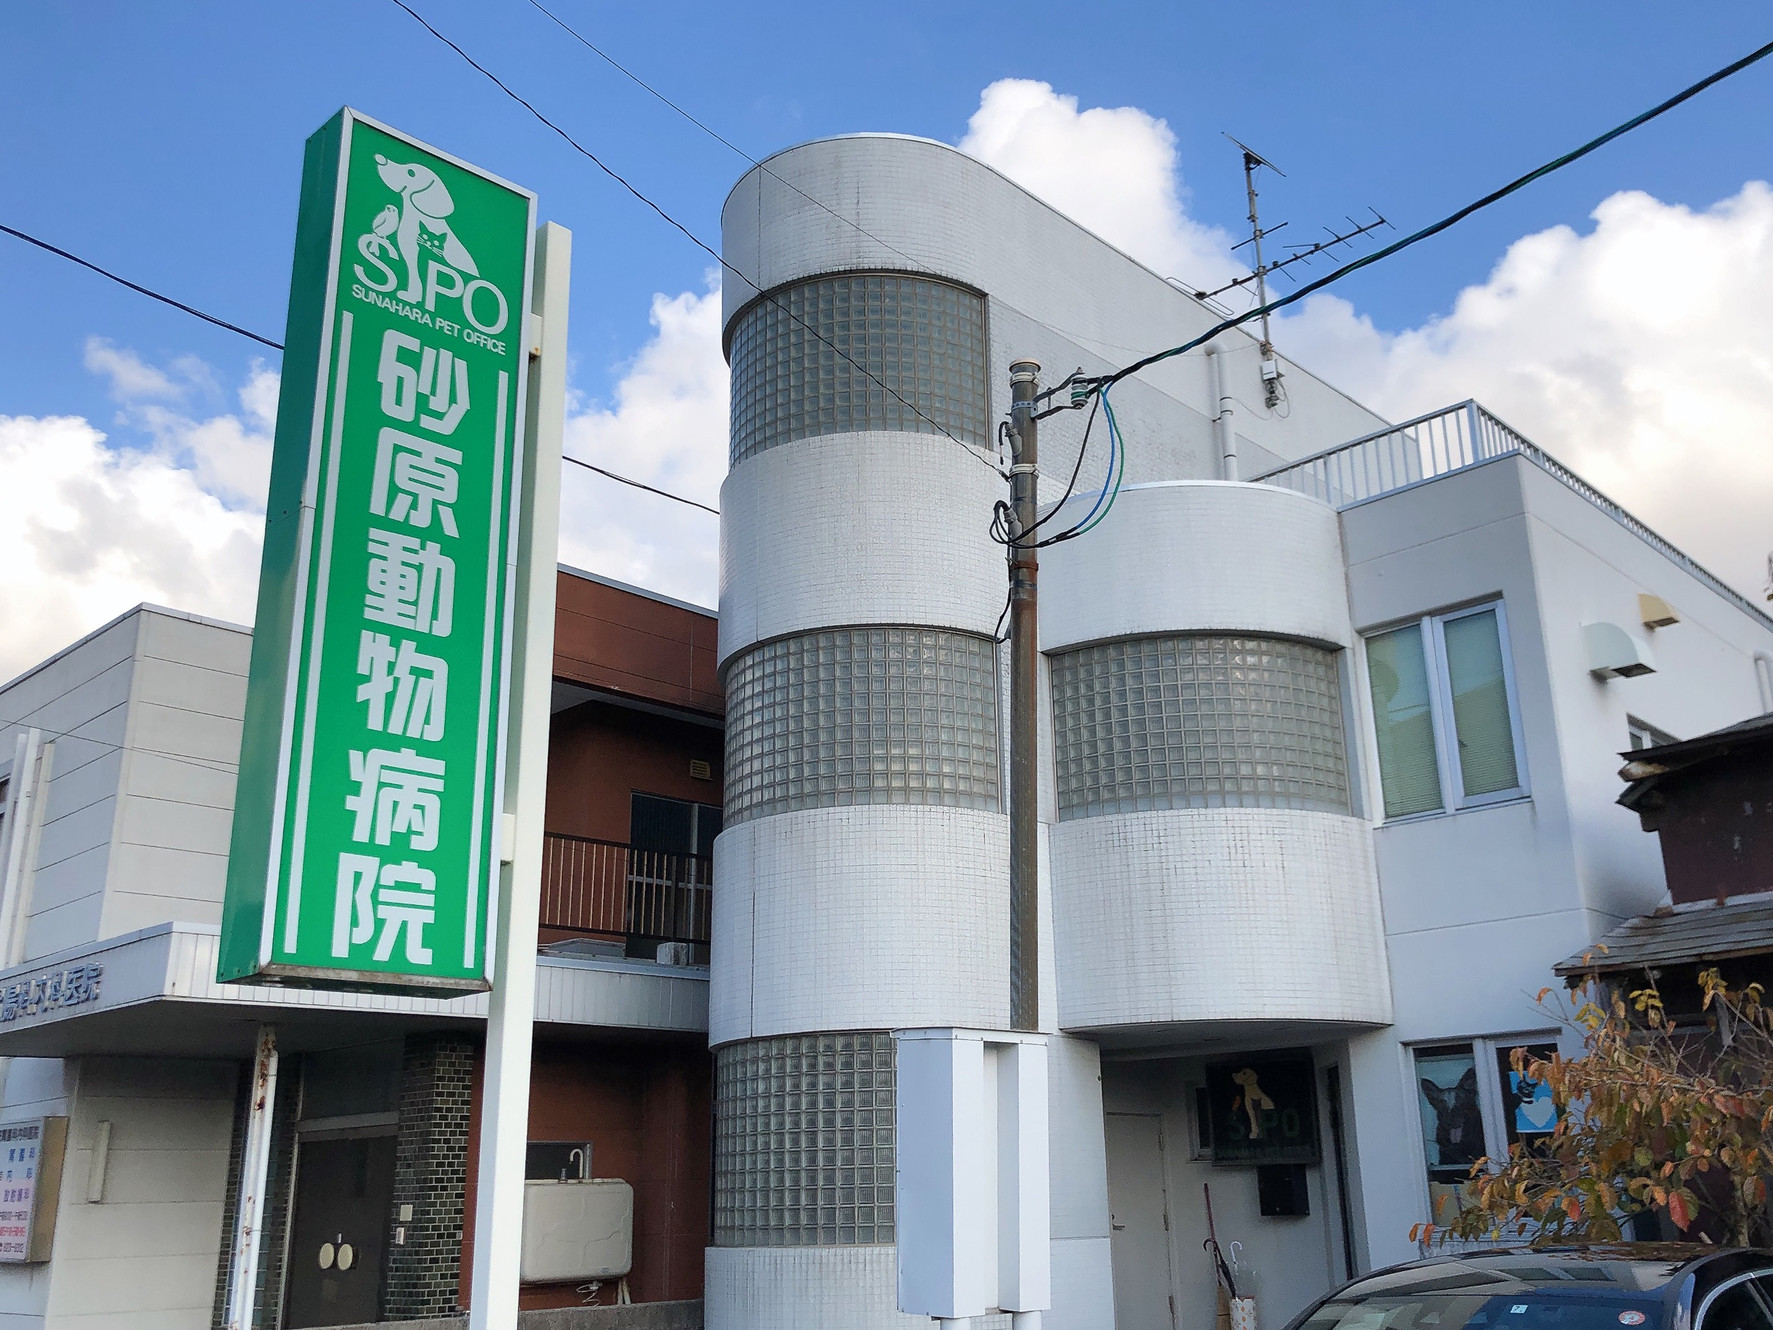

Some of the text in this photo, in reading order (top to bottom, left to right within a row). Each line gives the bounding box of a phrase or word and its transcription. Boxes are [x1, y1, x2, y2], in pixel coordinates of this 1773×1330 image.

[352, 284, 506, 356] SUNAHARA PET OFFICE
[331, 328, 471, 966] 砂原動物病院
